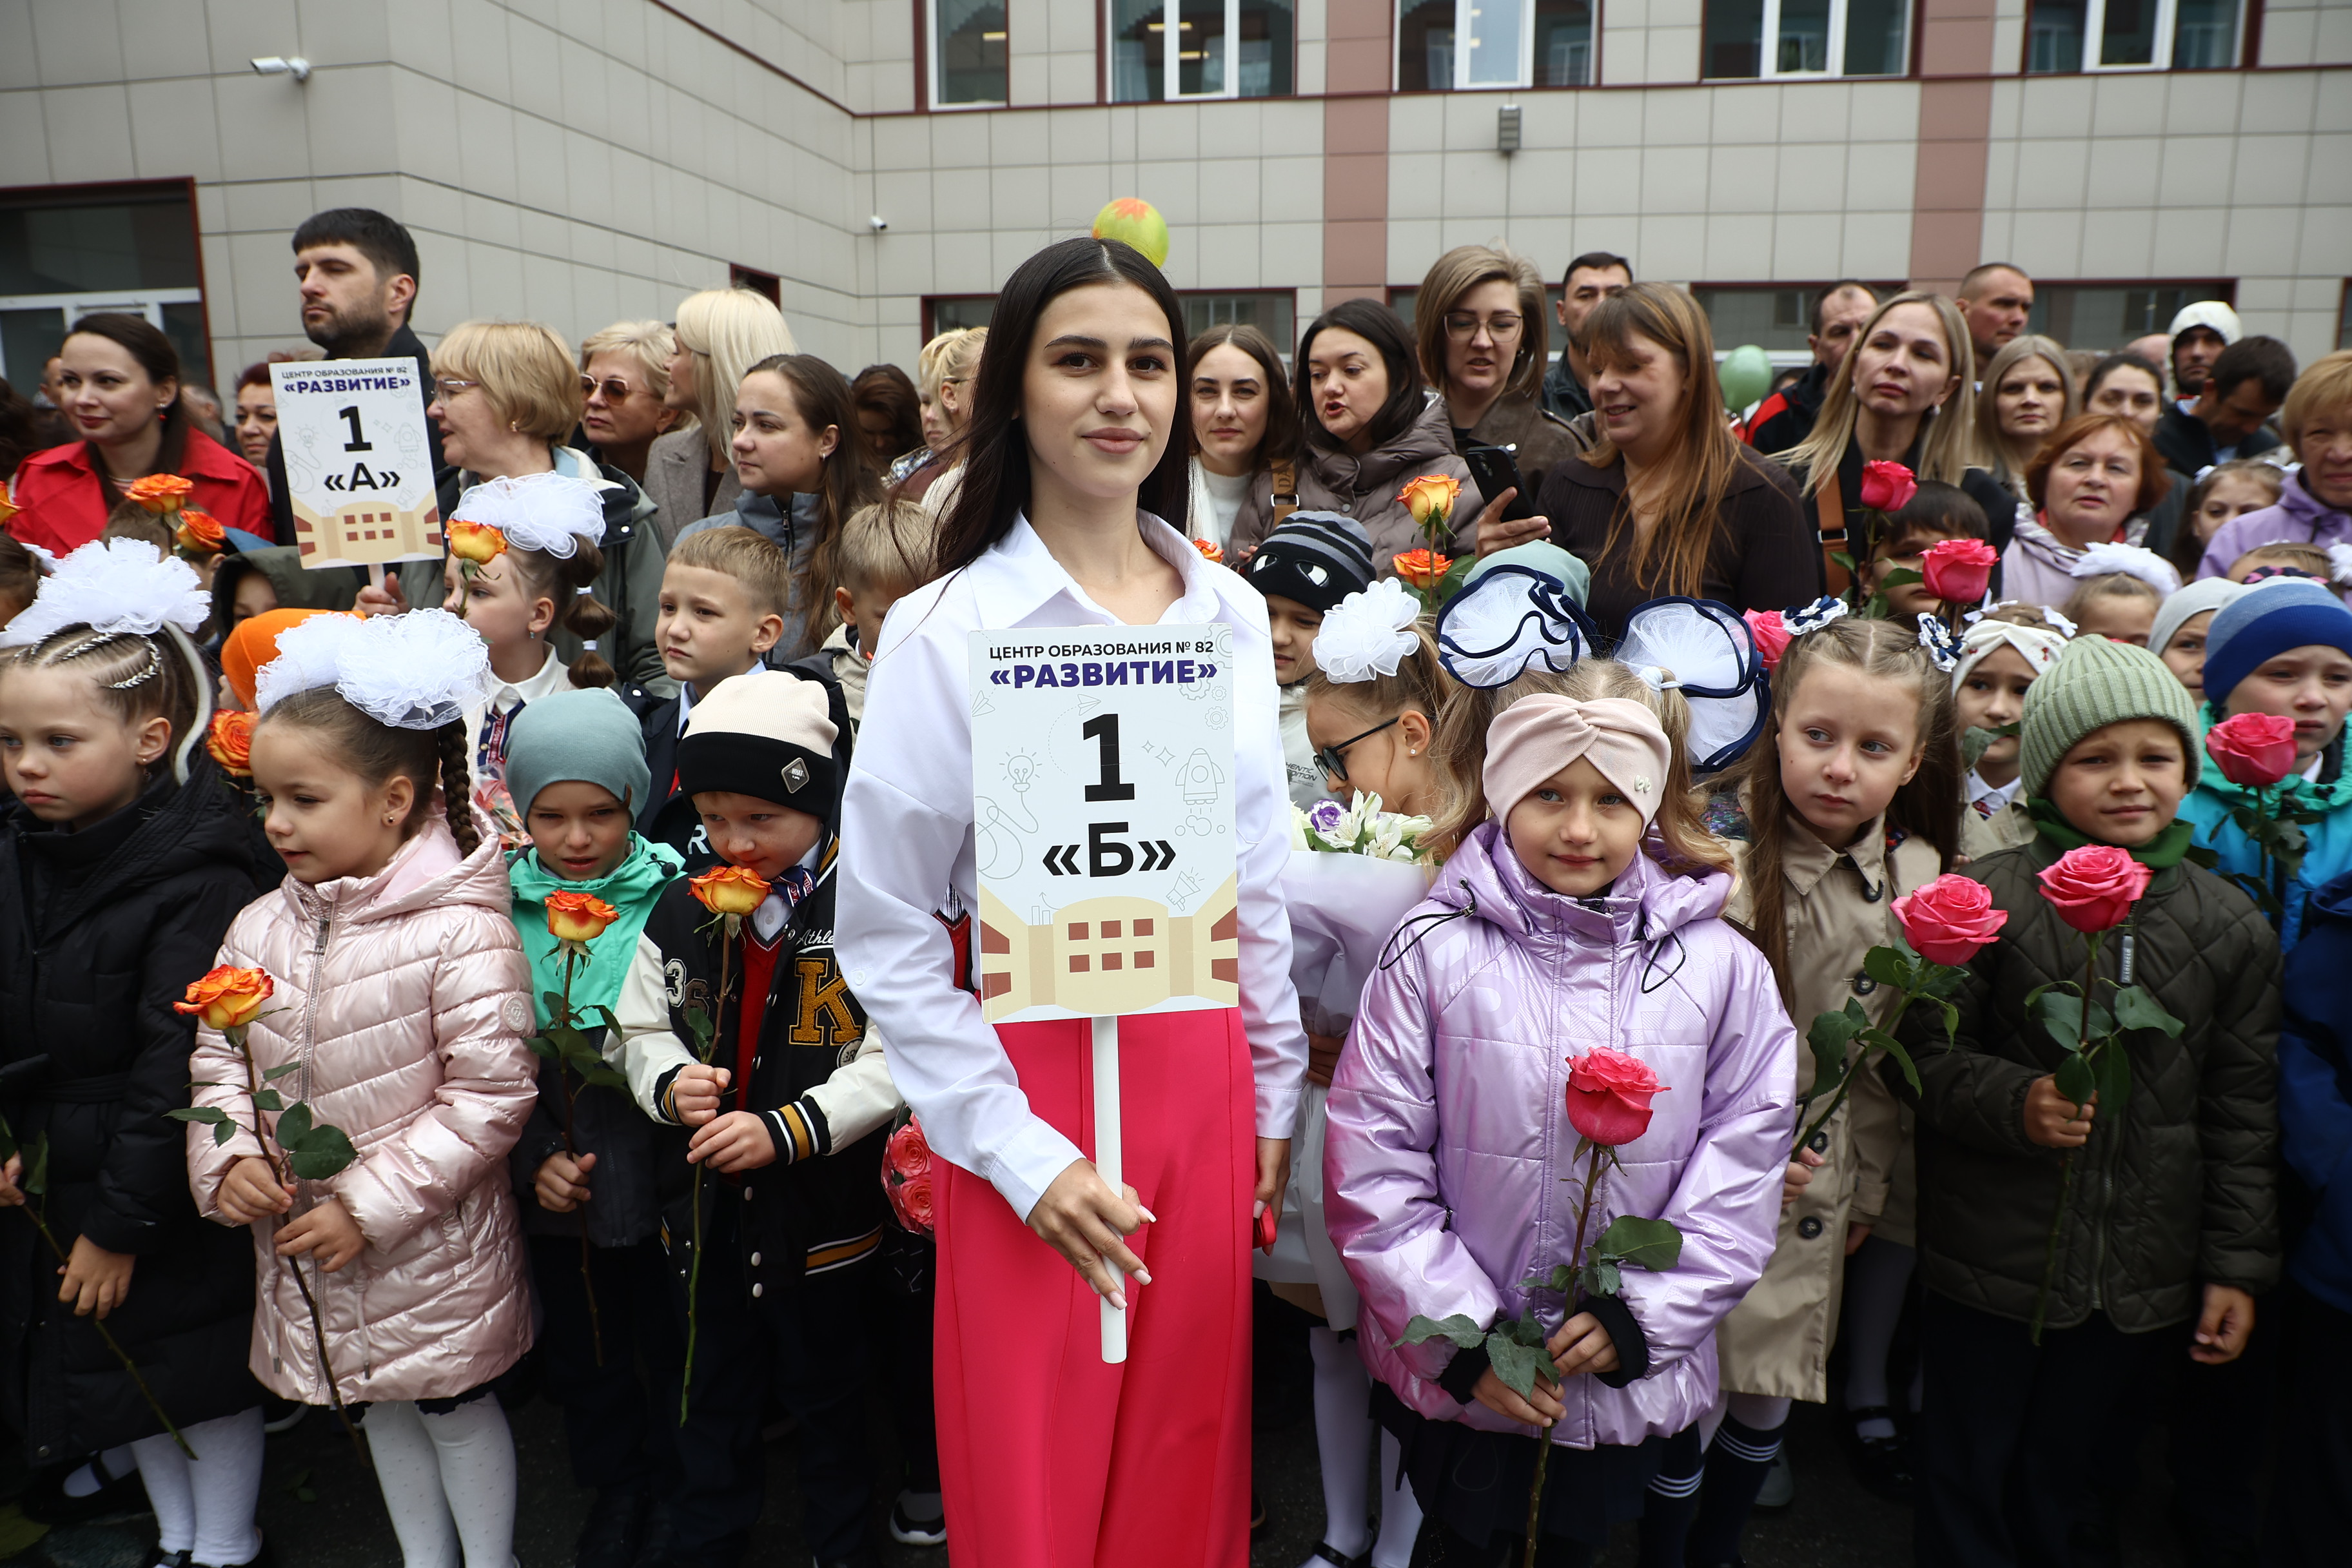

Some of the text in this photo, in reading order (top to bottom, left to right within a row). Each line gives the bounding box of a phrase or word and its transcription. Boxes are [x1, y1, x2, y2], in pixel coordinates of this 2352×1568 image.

[284, 377, 411, 394] «РАЗВИТИЕ»
[315, 368, 384, 377] ОБРАЗОВАНИЯ
[338, 406, 373, 453] 1
[324, 462, 401, 492] «А»
[989, 641, 1214, 662] ЦЕНТР ОБРАЗОВАНИЯ № 82
[989, 660, 1218, 689] «РАЗВИТИЕ»
[1083, 713, 1135, 803] 1
[1287, 769, 1317, 781] DITION
[1042, 821, 1177, 878] «Б»
[789, 957, 863, 1046] K
